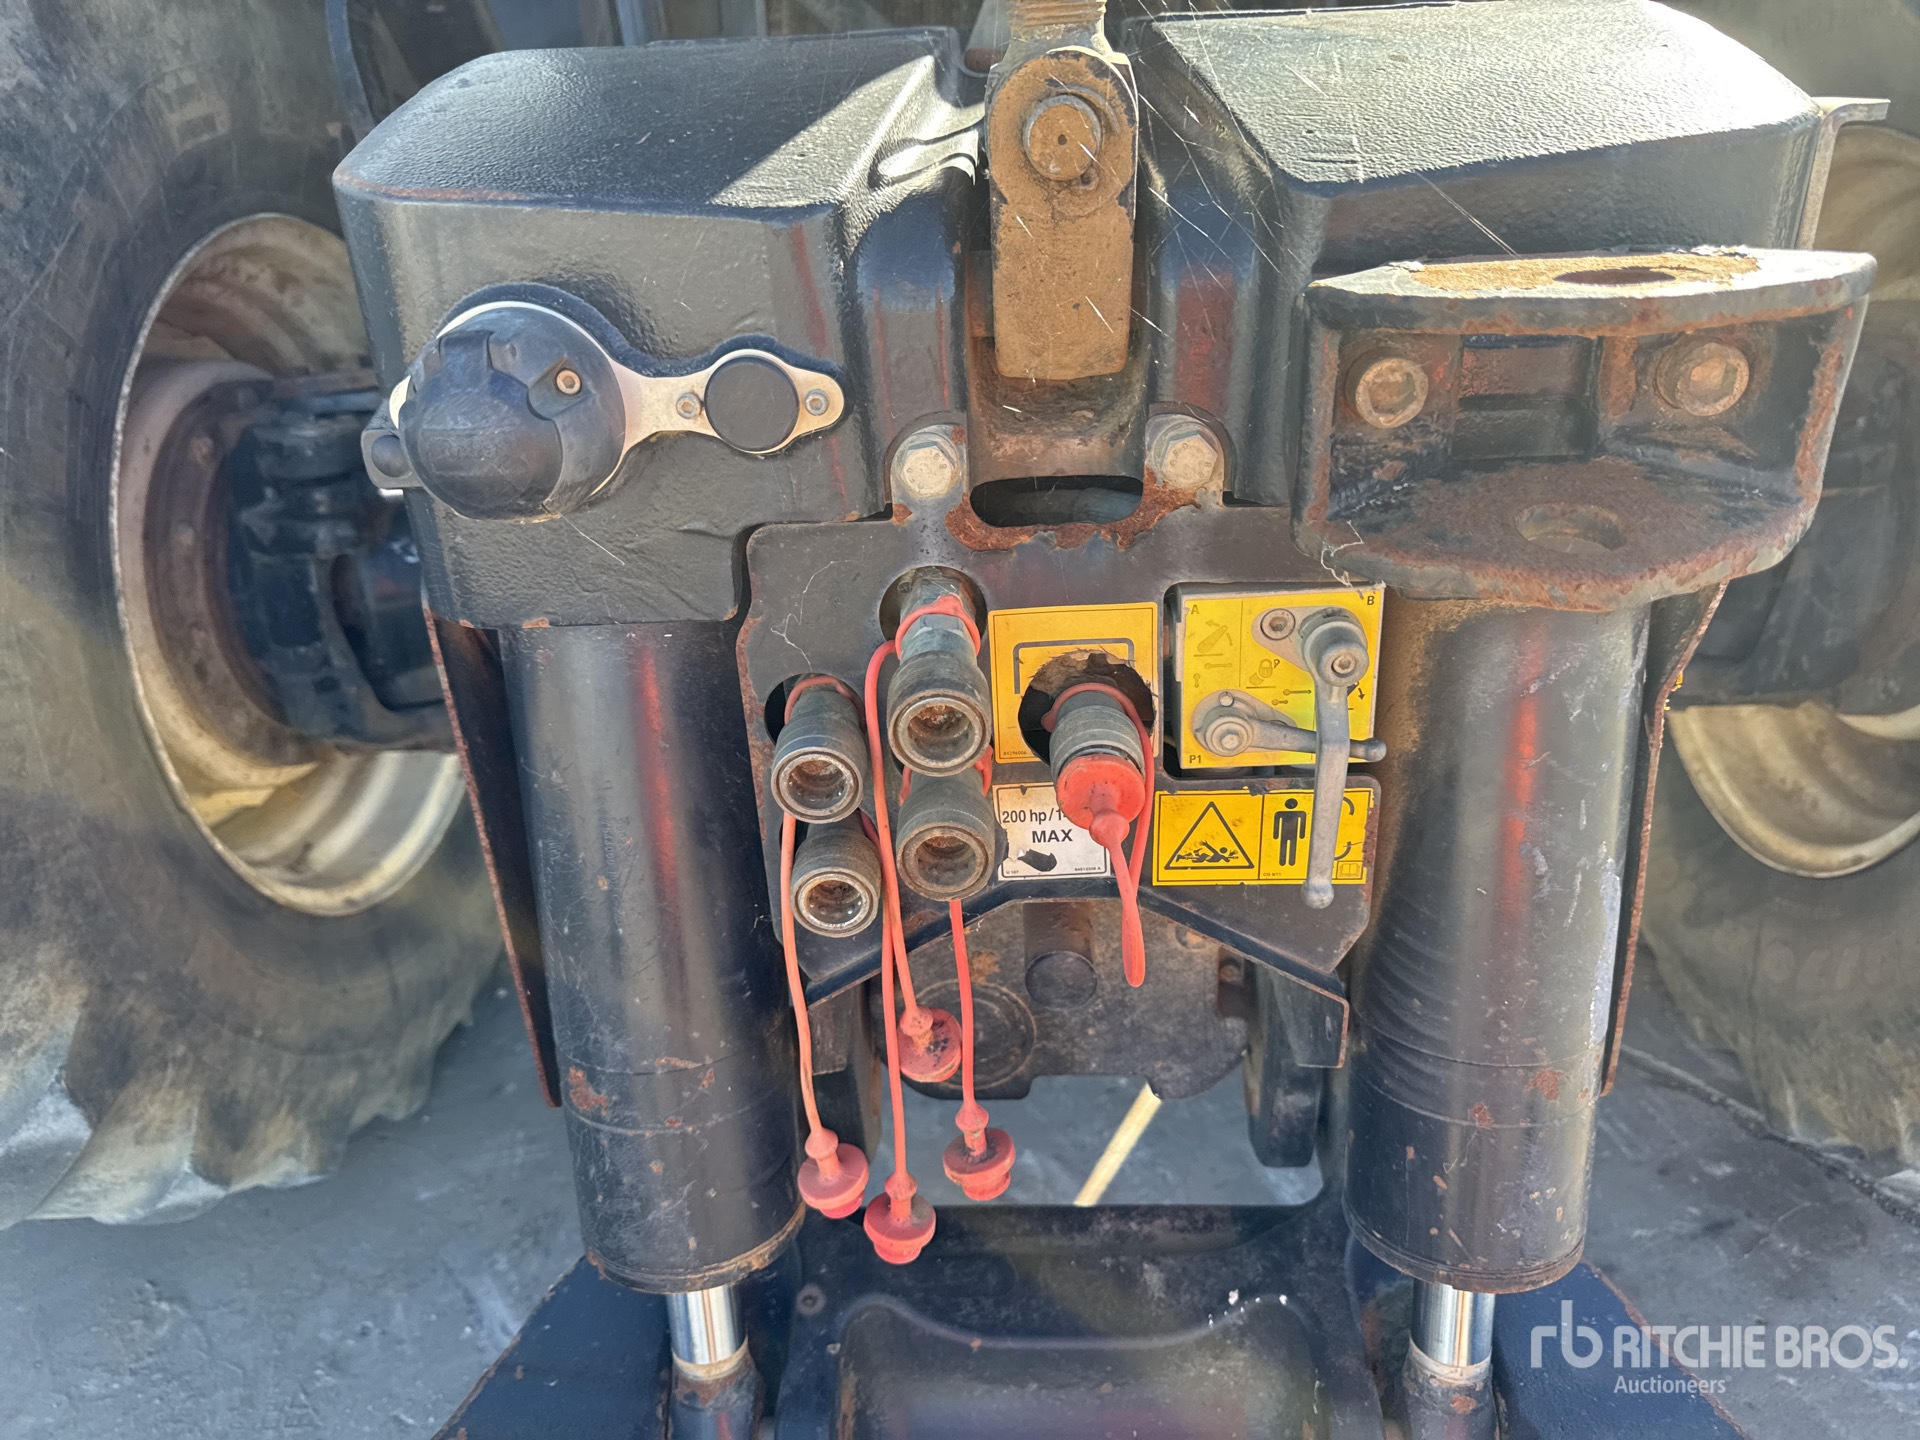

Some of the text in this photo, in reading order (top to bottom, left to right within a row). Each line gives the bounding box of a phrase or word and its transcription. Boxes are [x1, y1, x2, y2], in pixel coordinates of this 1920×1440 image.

[1366, 595, 1375, 606] B
[1190, 604, 1200, 615] A
[1189, 754, 1202, 764] P1
[1002, 807, 1066, 825] 200 hp/1
[1032, 829, 1073, 843] MAX
